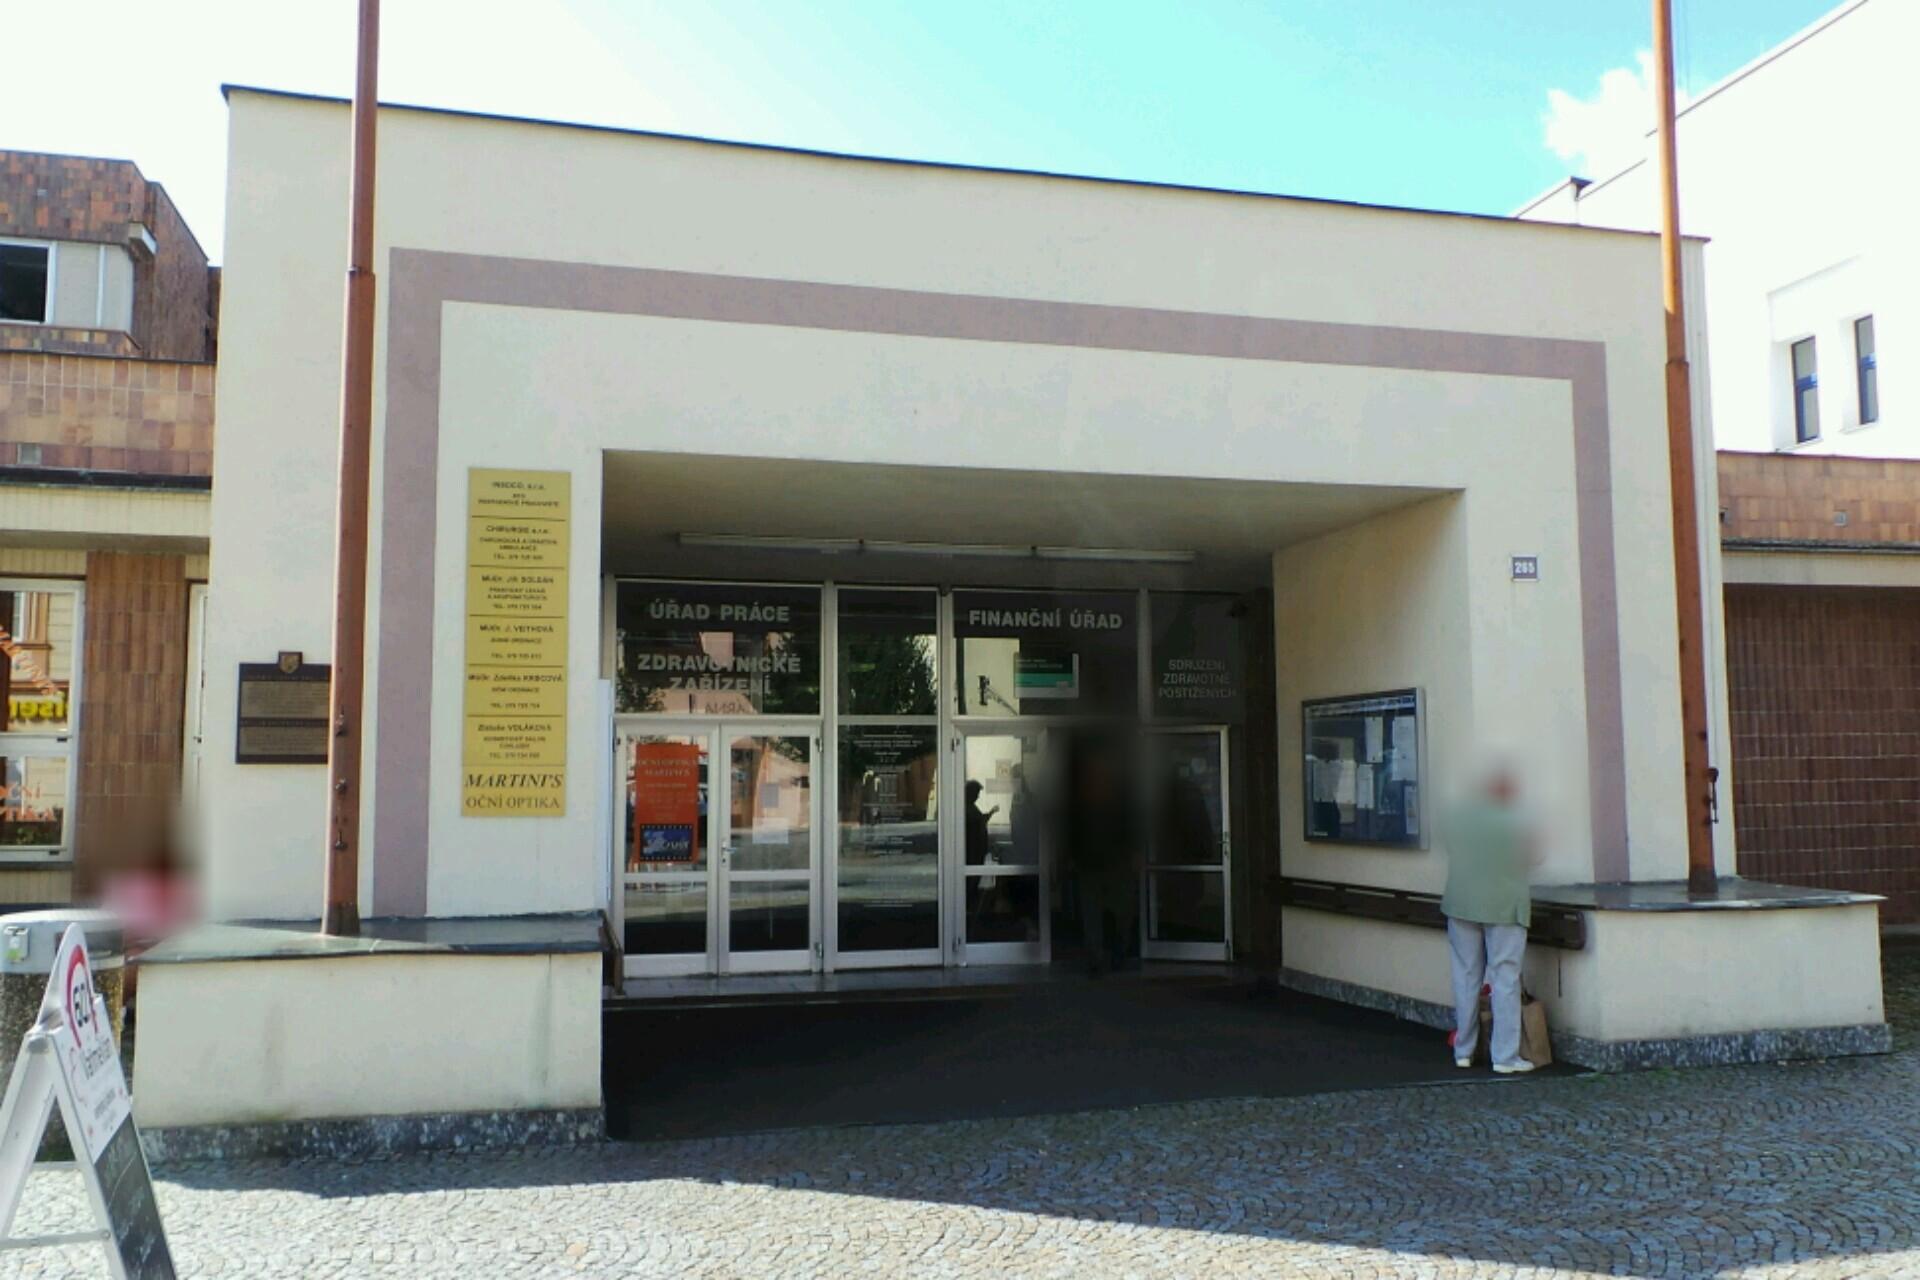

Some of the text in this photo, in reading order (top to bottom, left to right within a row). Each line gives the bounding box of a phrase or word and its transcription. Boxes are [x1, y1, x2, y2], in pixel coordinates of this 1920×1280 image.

[650, 598, 791, 623] ÚŘAD PRÁCE
[968, 607, 1124, 630] FINANČNÍ ÚŘAD
[637, 652, 802, 674] ZDRAVOTNICKÉ
[464, 773, 564, 788] MARTINI'S
[464, 793, 561, 809] OČNÍ OPTIKA
